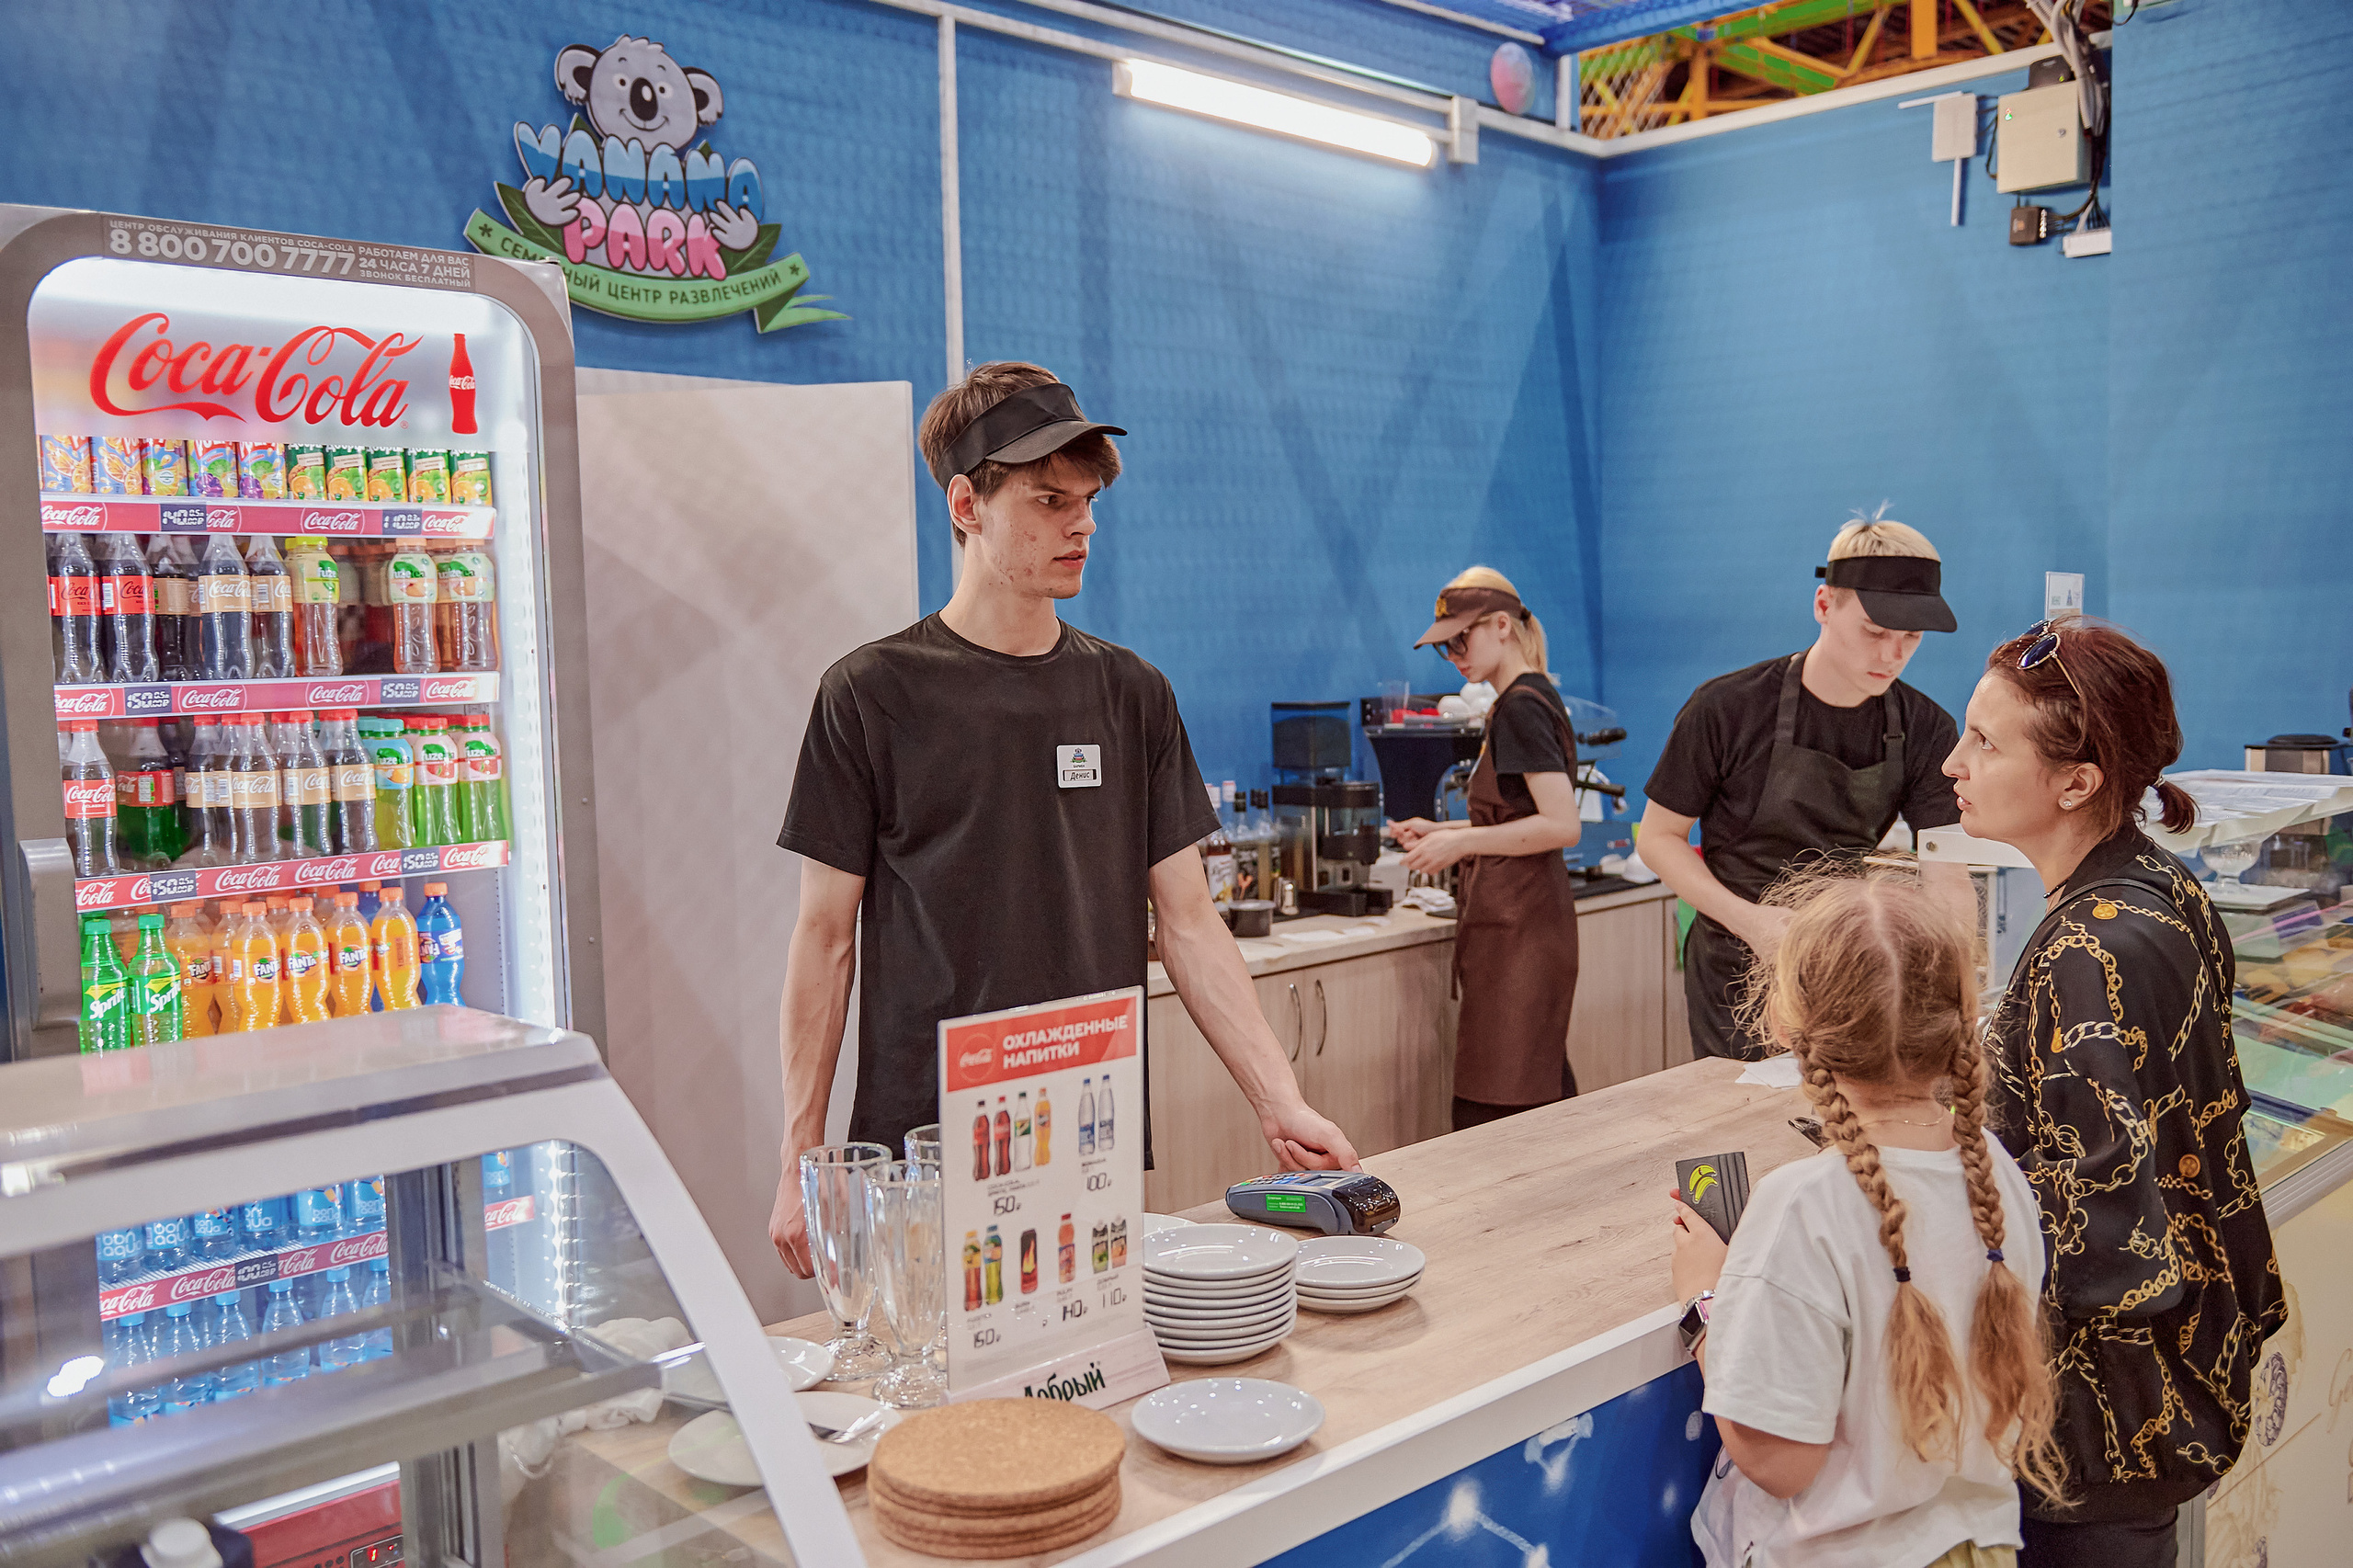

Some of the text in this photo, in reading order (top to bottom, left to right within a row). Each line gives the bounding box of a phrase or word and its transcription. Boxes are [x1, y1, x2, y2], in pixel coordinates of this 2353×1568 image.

[109, 220, 355, 253] ЦЕНТР ОБСЛУЖИВАНИЯ КЛИЕНТОВ COCA-COLA
[563, 196, 727, 280] PARK
[109, 229, 356, 276] 8 800 700 7777
[358, 246, 470, 266] РАБОТАЕМ ДЛЯ ВАС
[358, 257, 470, 278] 24 ЧАСА 7 ДНЕЙ
[359, 269, 471, 288] ЗВОНОК БЕСПЛАТНЫЙ
[500, 236, 782, 304] СЕМНЫЙ ЦЕНТР РАЗВЛЕЧЕНИЙ
[89, 312, 426, 428] Coca-Cola
[303, 511, 361, 530] Coca-Cola
[182, 688, 244, 709] Coca-Cola
[309, 684, 365, 704] Coca-Cola
[214, 863, 283, 892] Coca-Cola
[295, 858, 359, 883] Coca-Cola
[1002, 1014, 1128, 1051] ОХЛАЖДЕННЫЕ
[1003, 1040, 1080, 1070] НАПИТКИ
